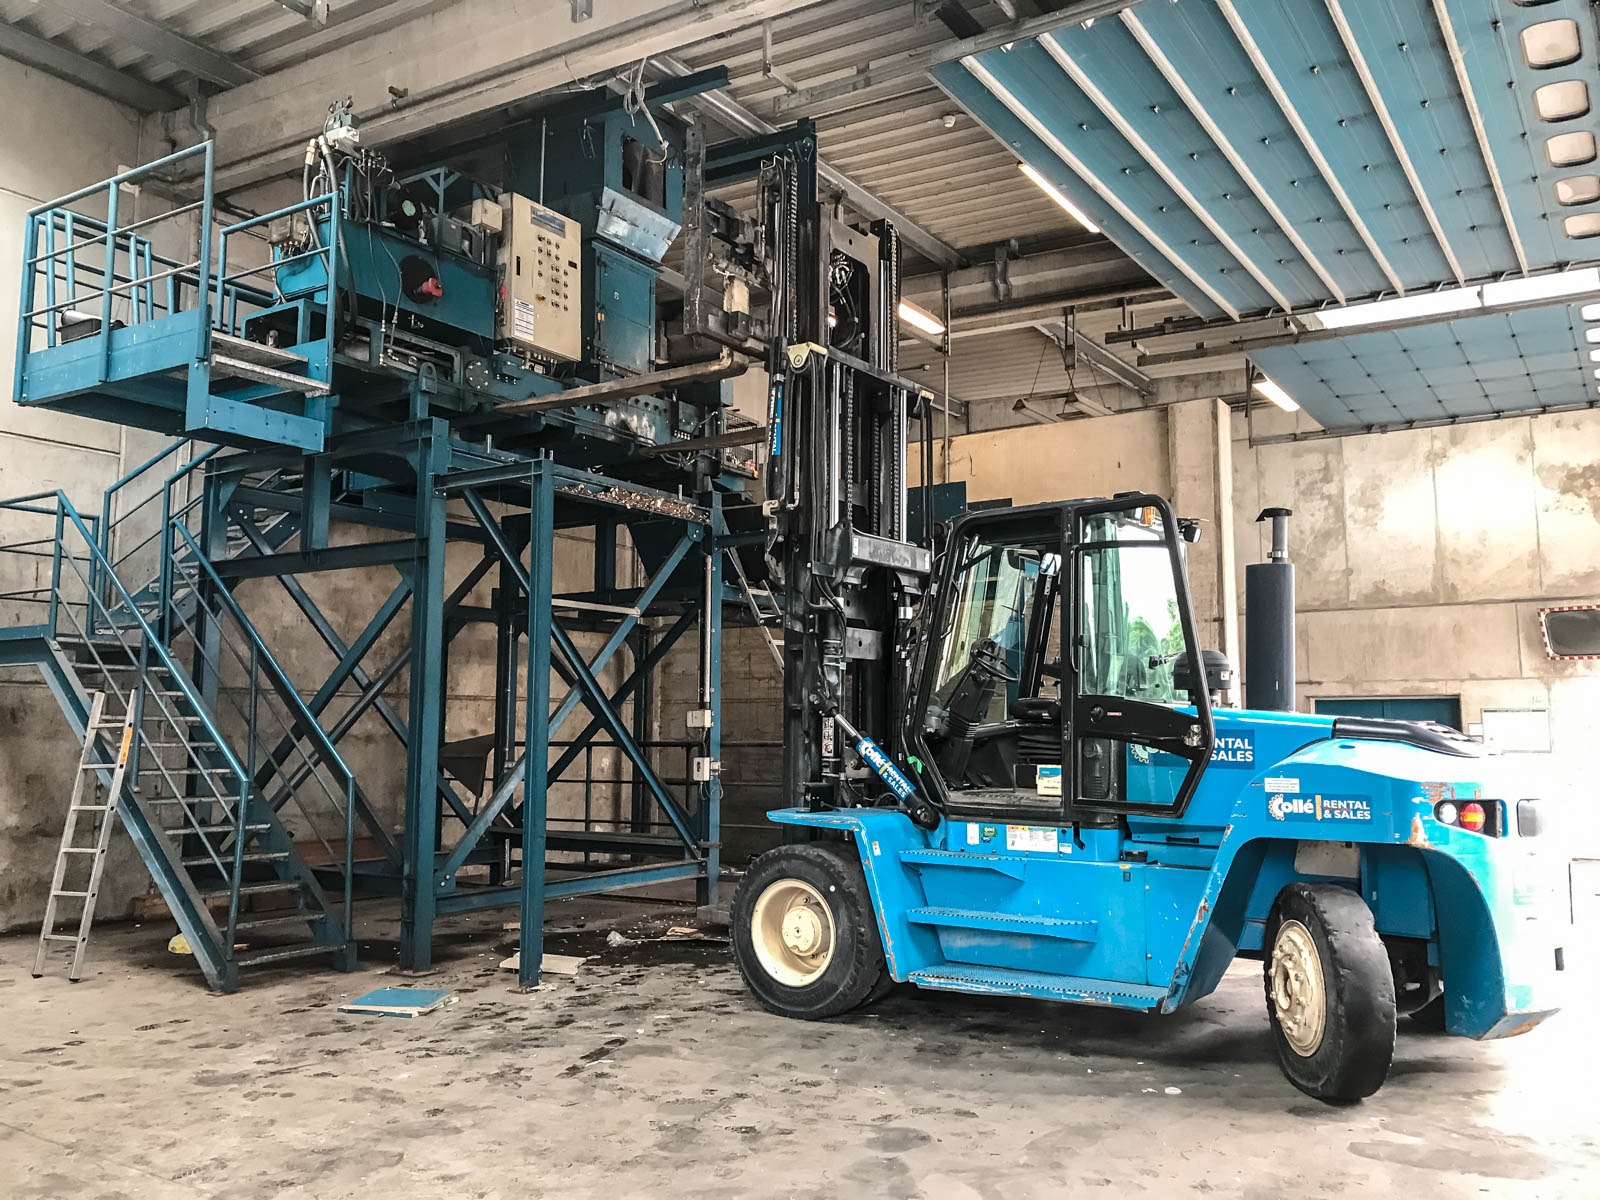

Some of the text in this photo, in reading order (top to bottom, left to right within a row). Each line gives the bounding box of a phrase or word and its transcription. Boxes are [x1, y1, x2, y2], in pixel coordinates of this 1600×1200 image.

[1214, 737, 1253, 749] NTAL
[1210, 750, 1254, 762] SALES
[886, 766, 912, 793] RENTAL
[887, 777, 906, 798] SALES
[1269, 795, 1314, 819] Collé
[1323, 800, 1370, 810] RENTAL
[1323, 810, 1371, 820] & SALES
